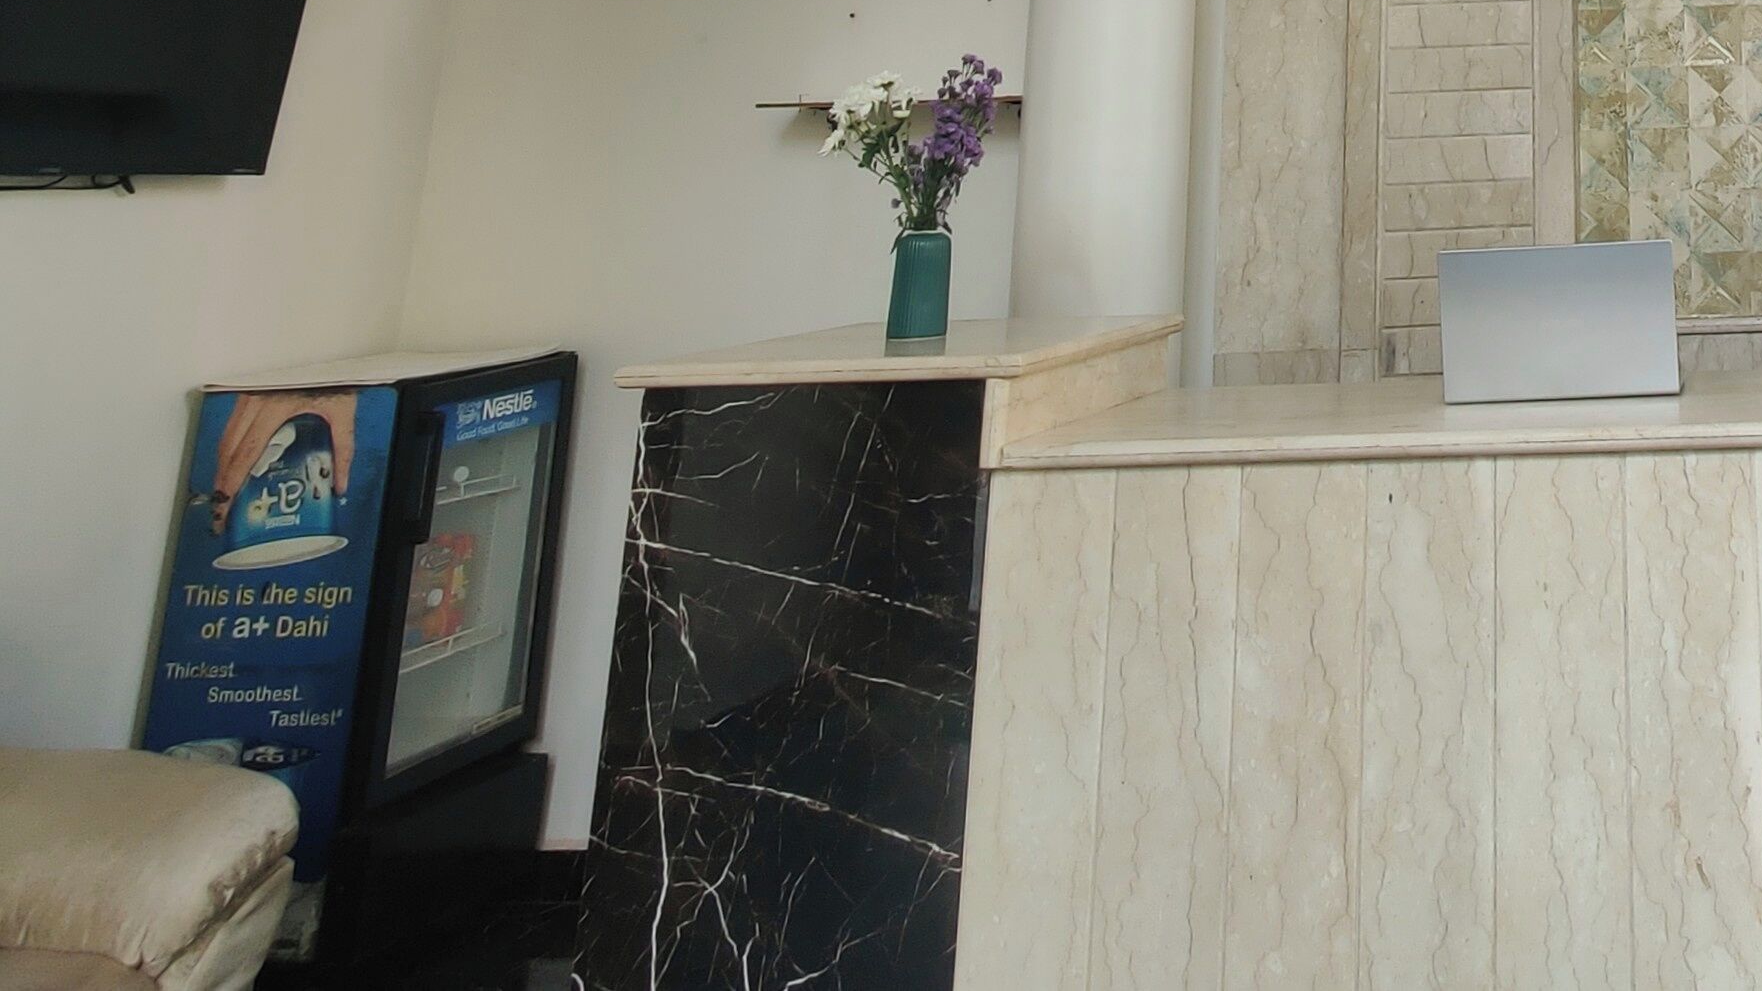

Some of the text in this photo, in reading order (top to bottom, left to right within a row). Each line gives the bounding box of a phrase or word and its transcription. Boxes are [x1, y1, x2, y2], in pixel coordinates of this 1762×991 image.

[183, 581, 353, 609] This is the sign
[201, 614, 330, 639] of a+ Dahi
